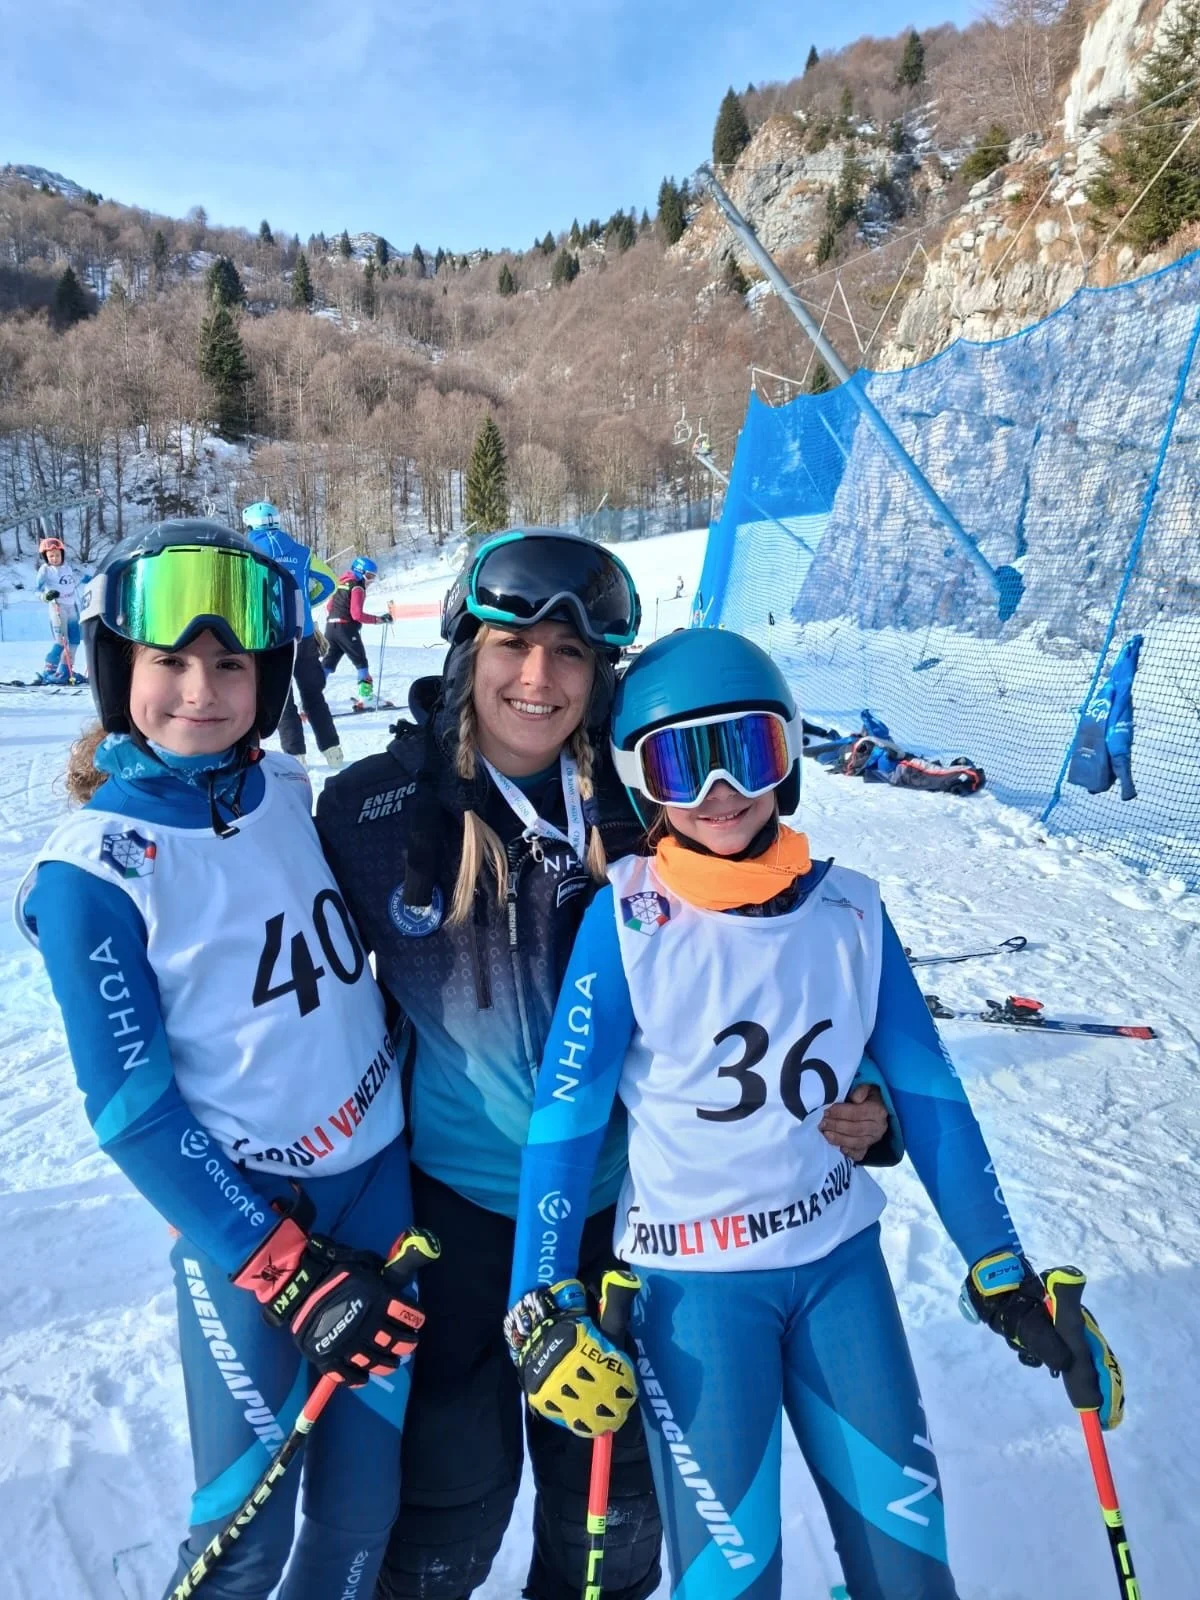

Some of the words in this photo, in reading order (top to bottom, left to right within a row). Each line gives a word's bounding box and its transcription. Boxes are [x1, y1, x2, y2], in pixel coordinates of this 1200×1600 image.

[358, 800, 402, 823] PURA
[362, 782, 416, 810] ENERG
[252, 888, 365, 1017] 40
[328, 1050, 391, 1138] VENEZIA
[696, 1018, 839, 1122] 36
[204, 1158, 265, 1227] atlante
[710, 1193, 822, 1251] VENEZIA
[273, 1269, 310, 1315] LEKI
[315, 1299, 363, 1352] reusch
[533, 1338, 565, 1375] LEVEL
[580, 1343, 625, 1377] LEVEL
